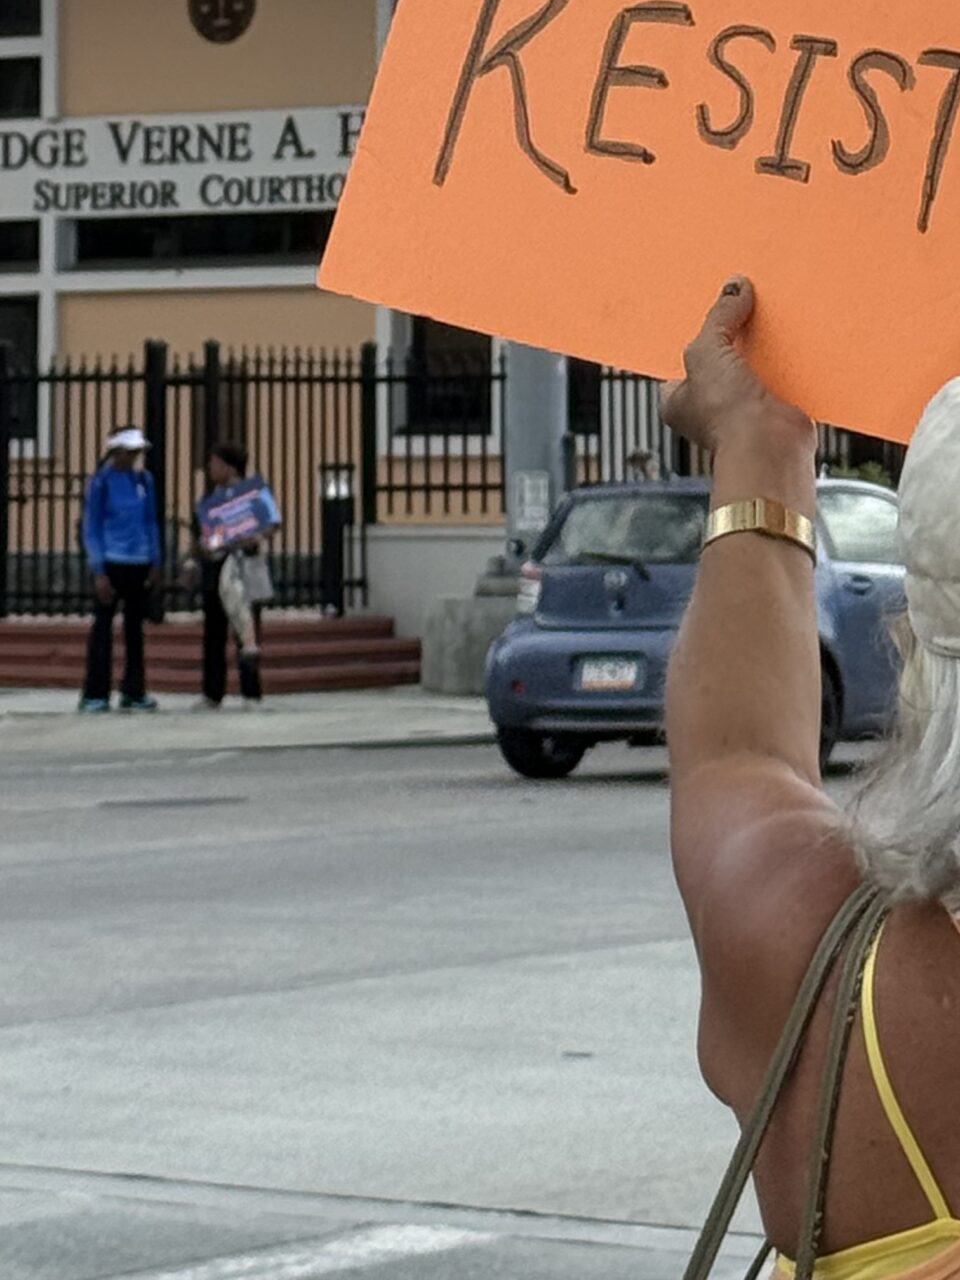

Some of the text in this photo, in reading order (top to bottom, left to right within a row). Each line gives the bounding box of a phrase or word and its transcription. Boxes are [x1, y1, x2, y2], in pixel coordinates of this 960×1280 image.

[107, 122, 252, 165] VERNE
[273, 115, 316, 159] A.
[33, 179, 179, 211] SUPERIOR
